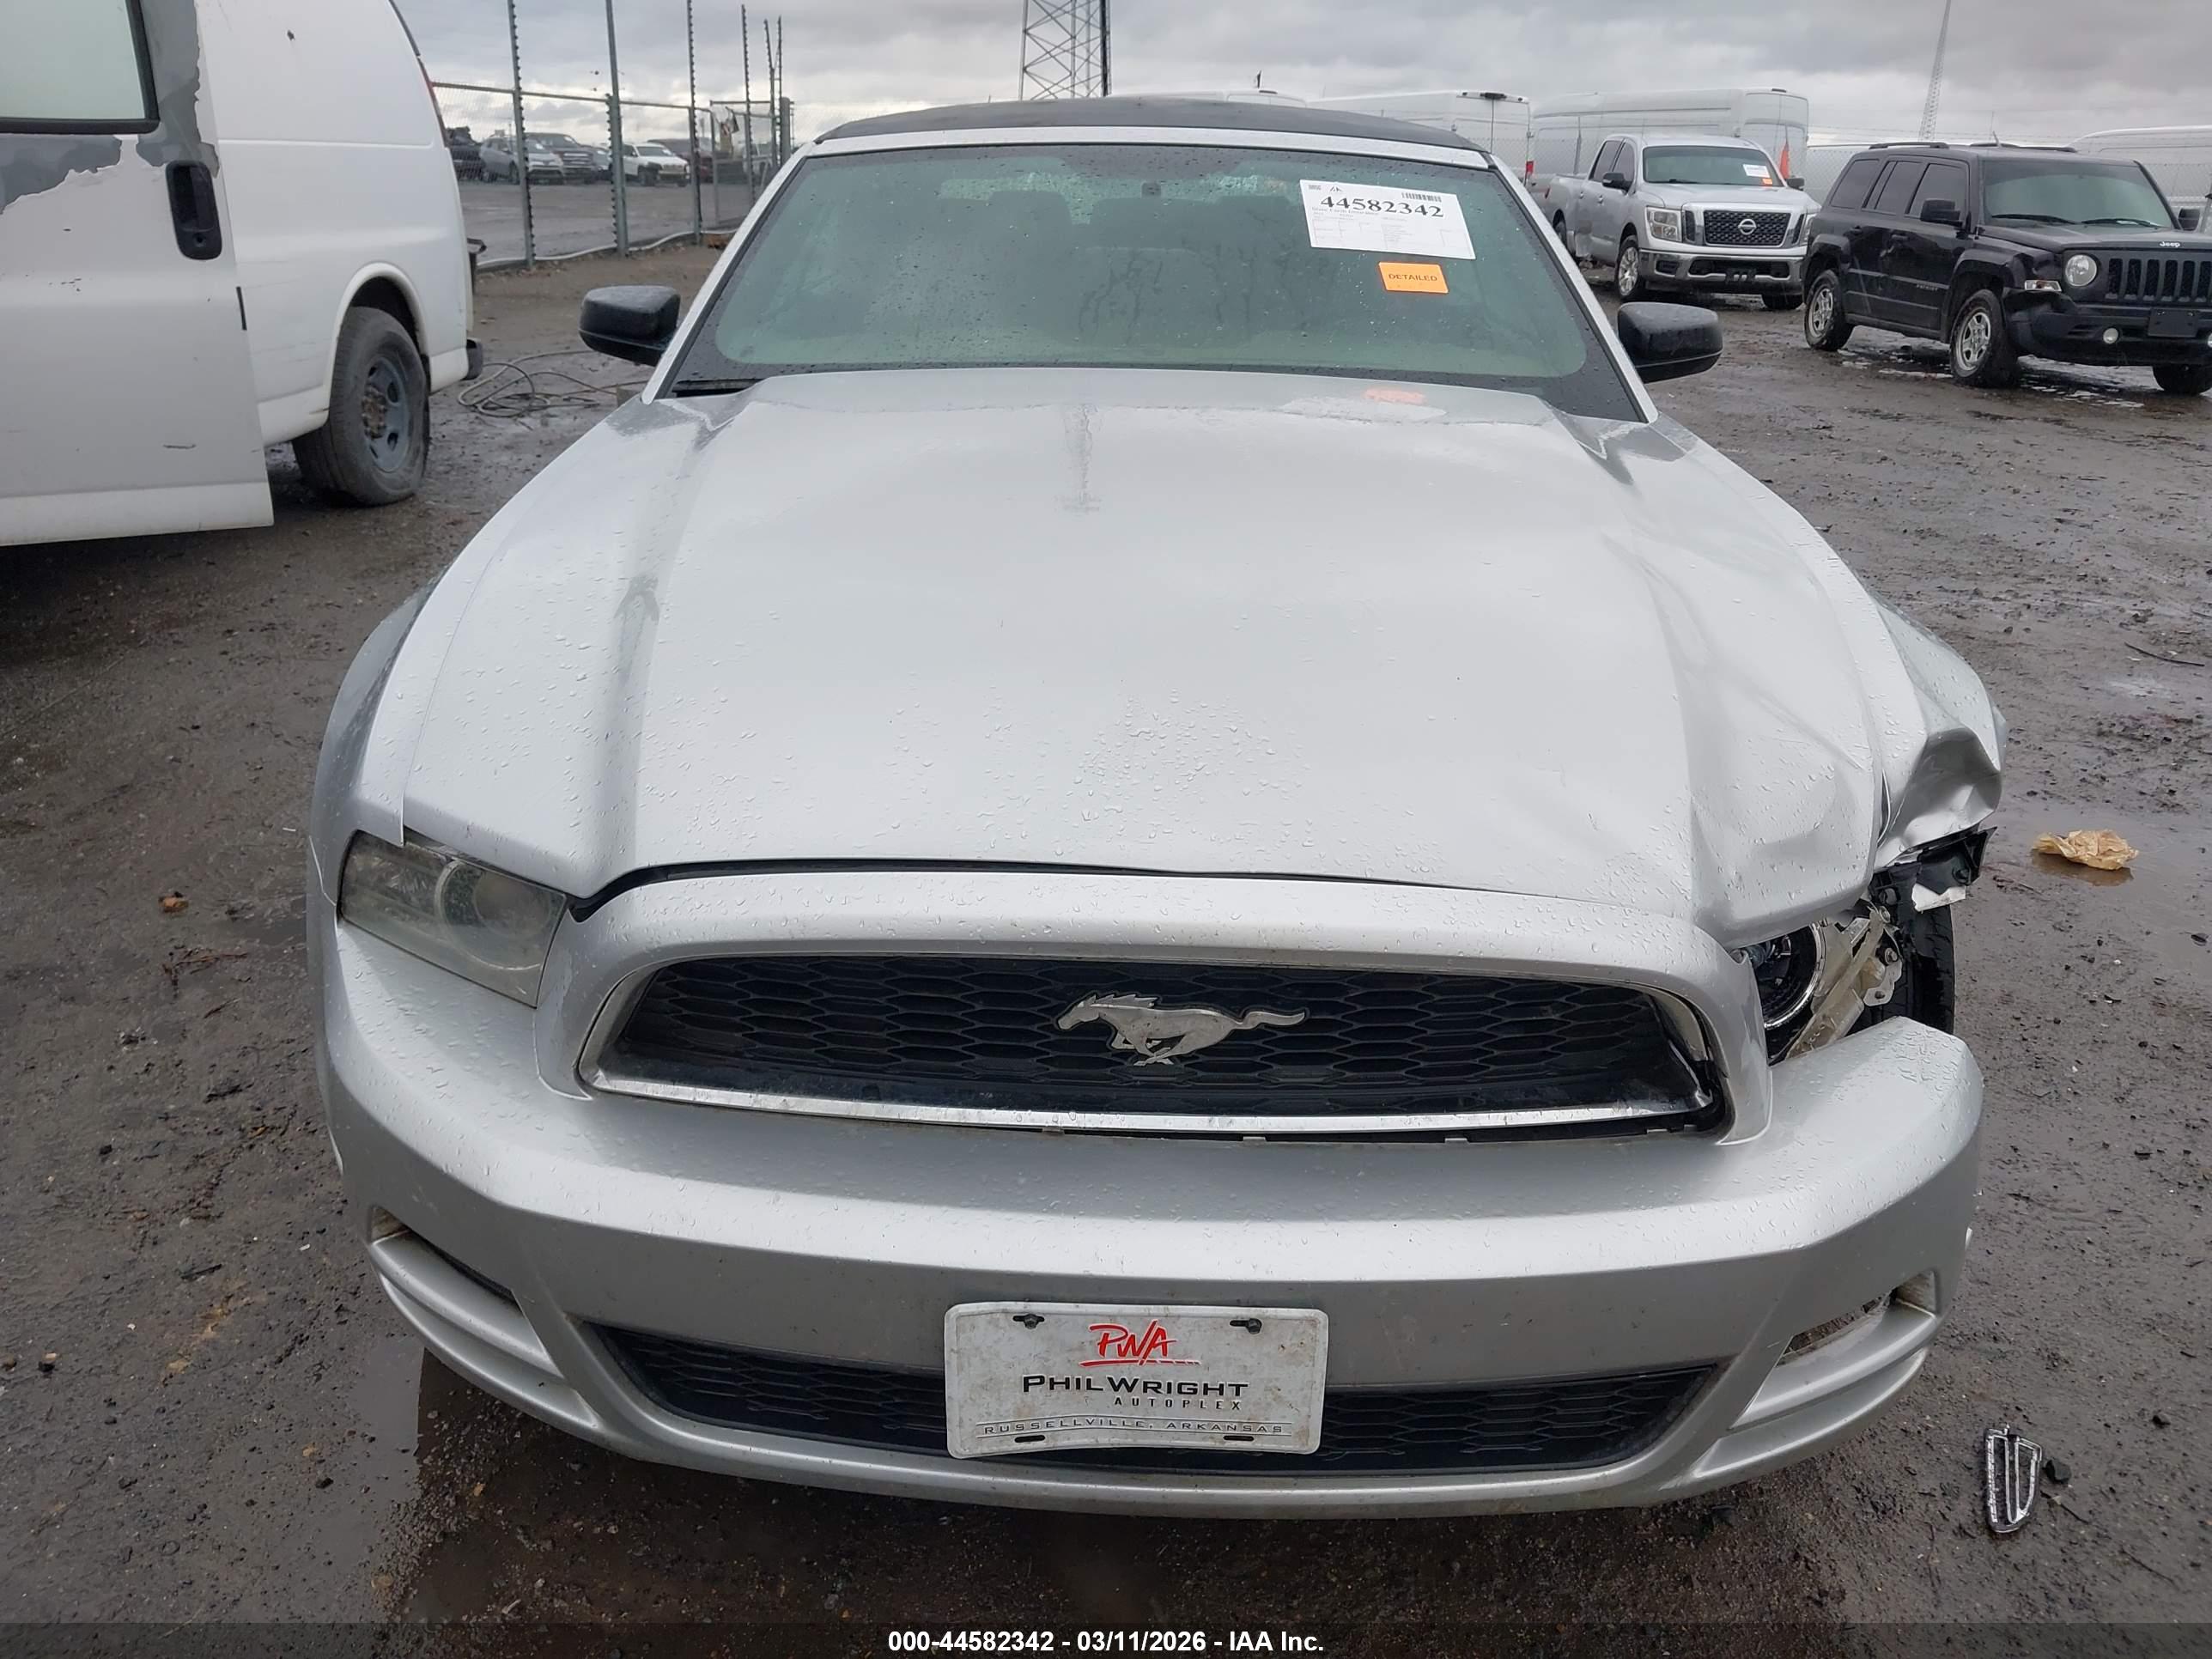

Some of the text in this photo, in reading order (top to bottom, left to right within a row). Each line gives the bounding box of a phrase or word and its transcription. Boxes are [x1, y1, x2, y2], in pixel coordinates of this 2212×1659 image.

[1320, 196, 1443, 217] 44582342
[1114, 1396, 1241, 1411] AUTOPLEX
[1166, 1422, 1282, 1433] ARKANSAS
